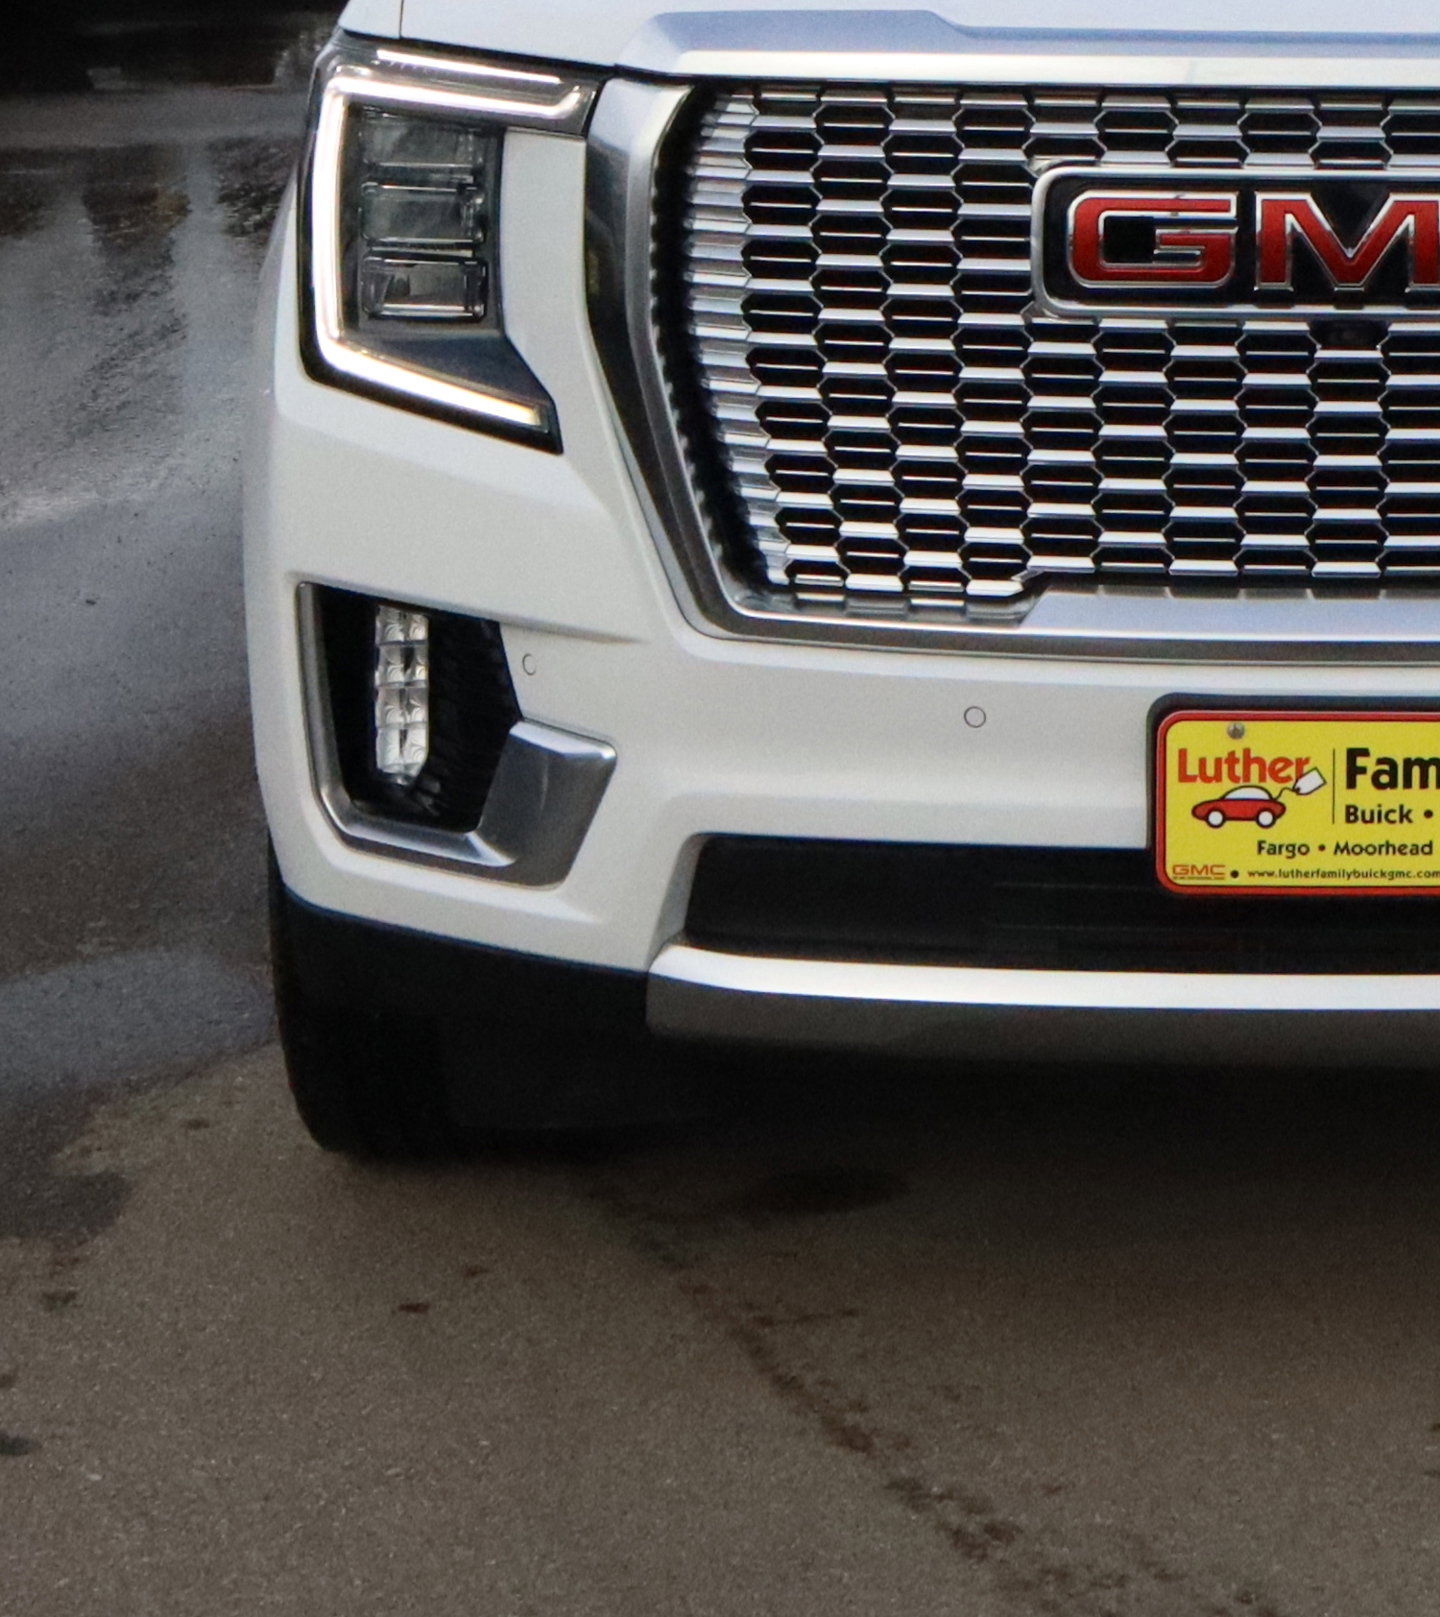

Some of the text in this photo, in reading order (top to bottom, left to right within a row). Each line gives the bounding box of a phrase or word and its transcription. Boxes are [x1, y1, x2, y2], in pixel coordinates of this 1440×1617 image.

[1177, 747, 1311, 784] Luther
[1344, 804, 1413, 824] Buick
[1257, 840, 1433, 859] Fargo Moorhead
[1172, 864, 1226, 875] GMC
